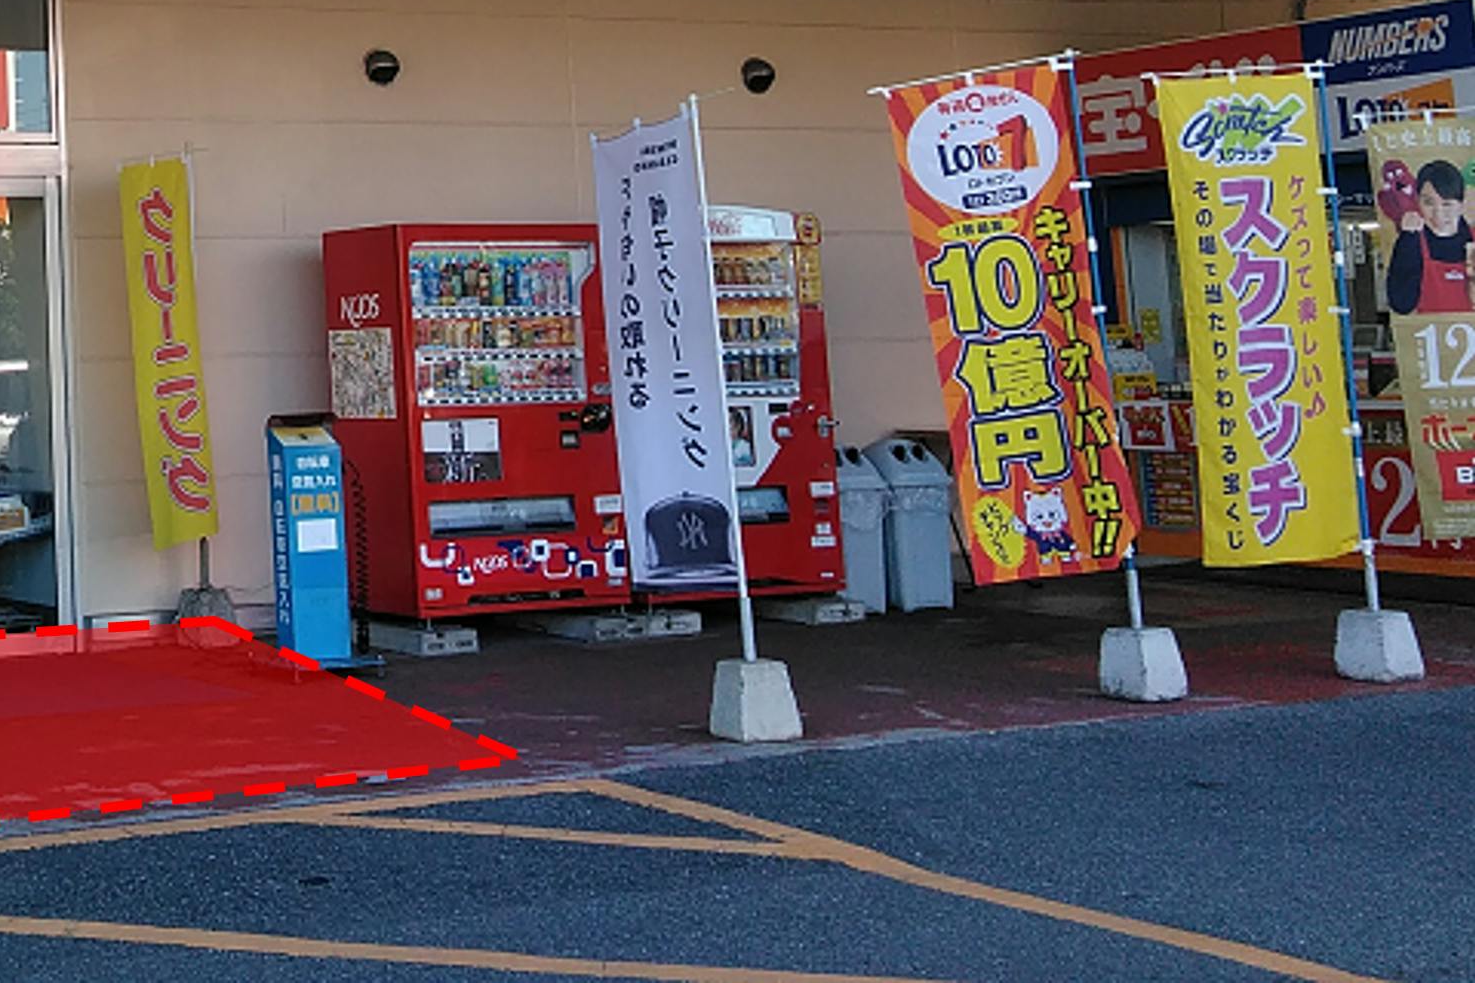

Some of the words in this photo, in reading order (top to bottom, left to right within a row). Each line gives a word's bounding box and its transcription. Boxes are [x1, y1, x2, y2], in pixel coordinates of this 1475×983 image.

[1327, 14, 1449, 64] NUMBERS
[937, 143, 996, 176] LOTO
[1219, 177, 1306, 546] スクラッチ
